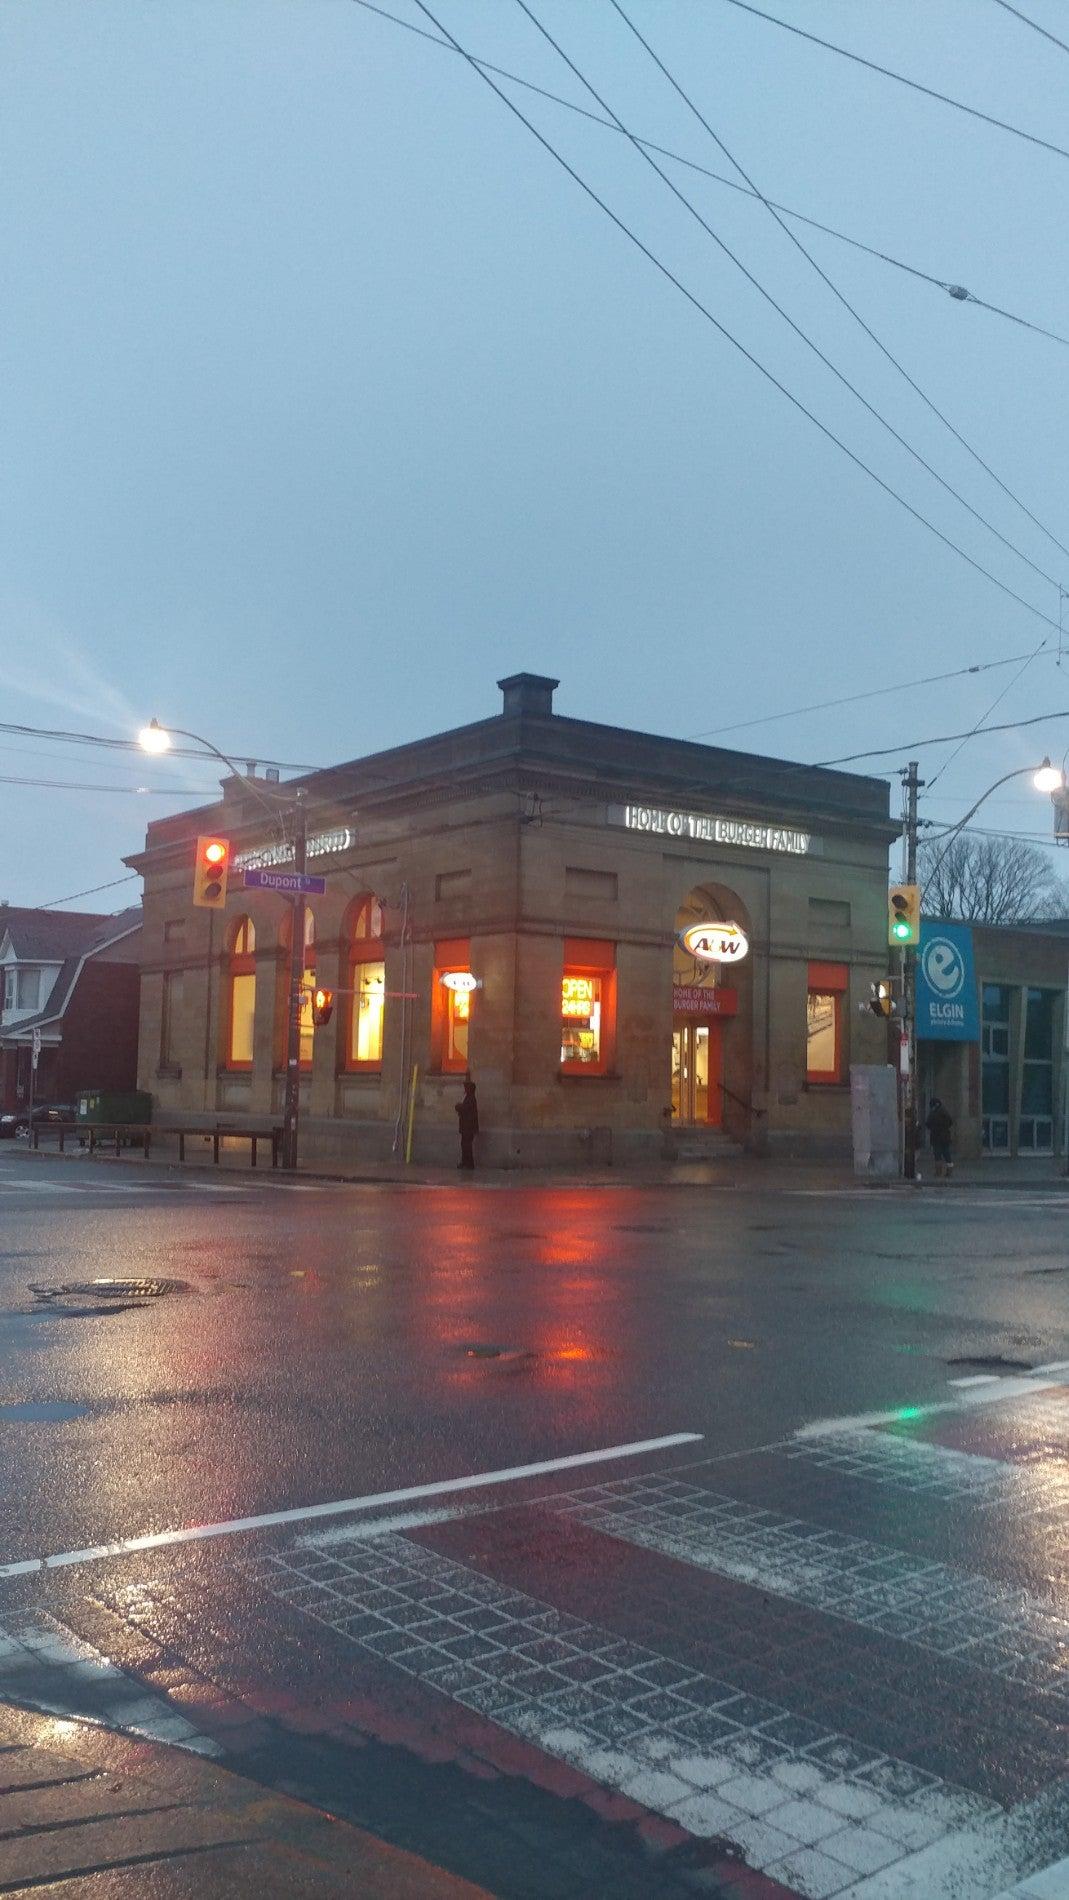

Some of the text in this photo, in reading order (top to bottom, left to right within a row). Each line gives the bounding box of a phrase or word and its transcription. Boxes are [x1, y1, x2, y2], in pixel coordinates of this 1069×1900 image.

[715, 819, 766, 848] BURGER
[260, 872, 302, 889] Dupont
[562, 978, 593, 999] OPEN
[929, 1002, 964, 1019] ELGIN
